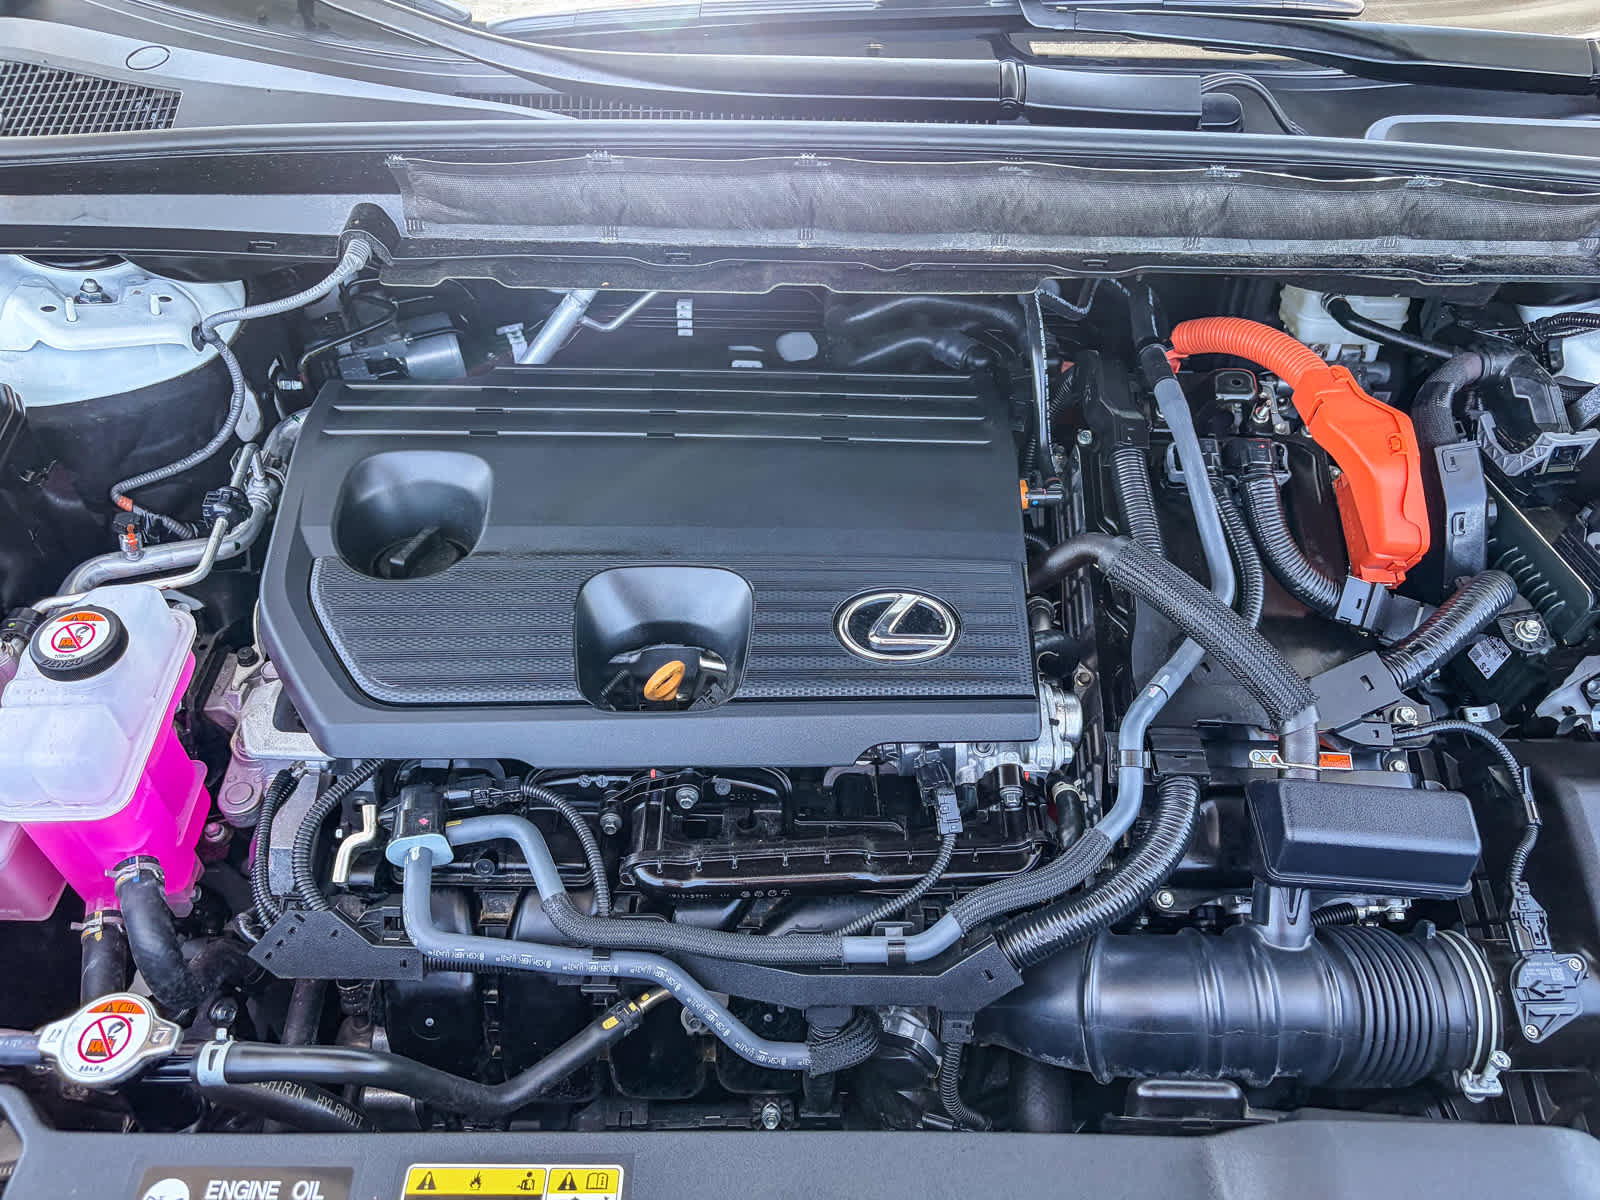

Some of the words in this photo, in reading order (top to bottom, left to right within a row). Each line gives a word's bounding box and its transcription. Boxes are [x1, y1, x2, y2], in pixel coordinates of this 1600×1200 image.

[41, 657, 83, 668] DENSO
[315, 1094, 364, 1128] HYLAMMIT
[204, 1180, 281, 1200] ENGINE
[292, 1180, 324, 1200] OIL
